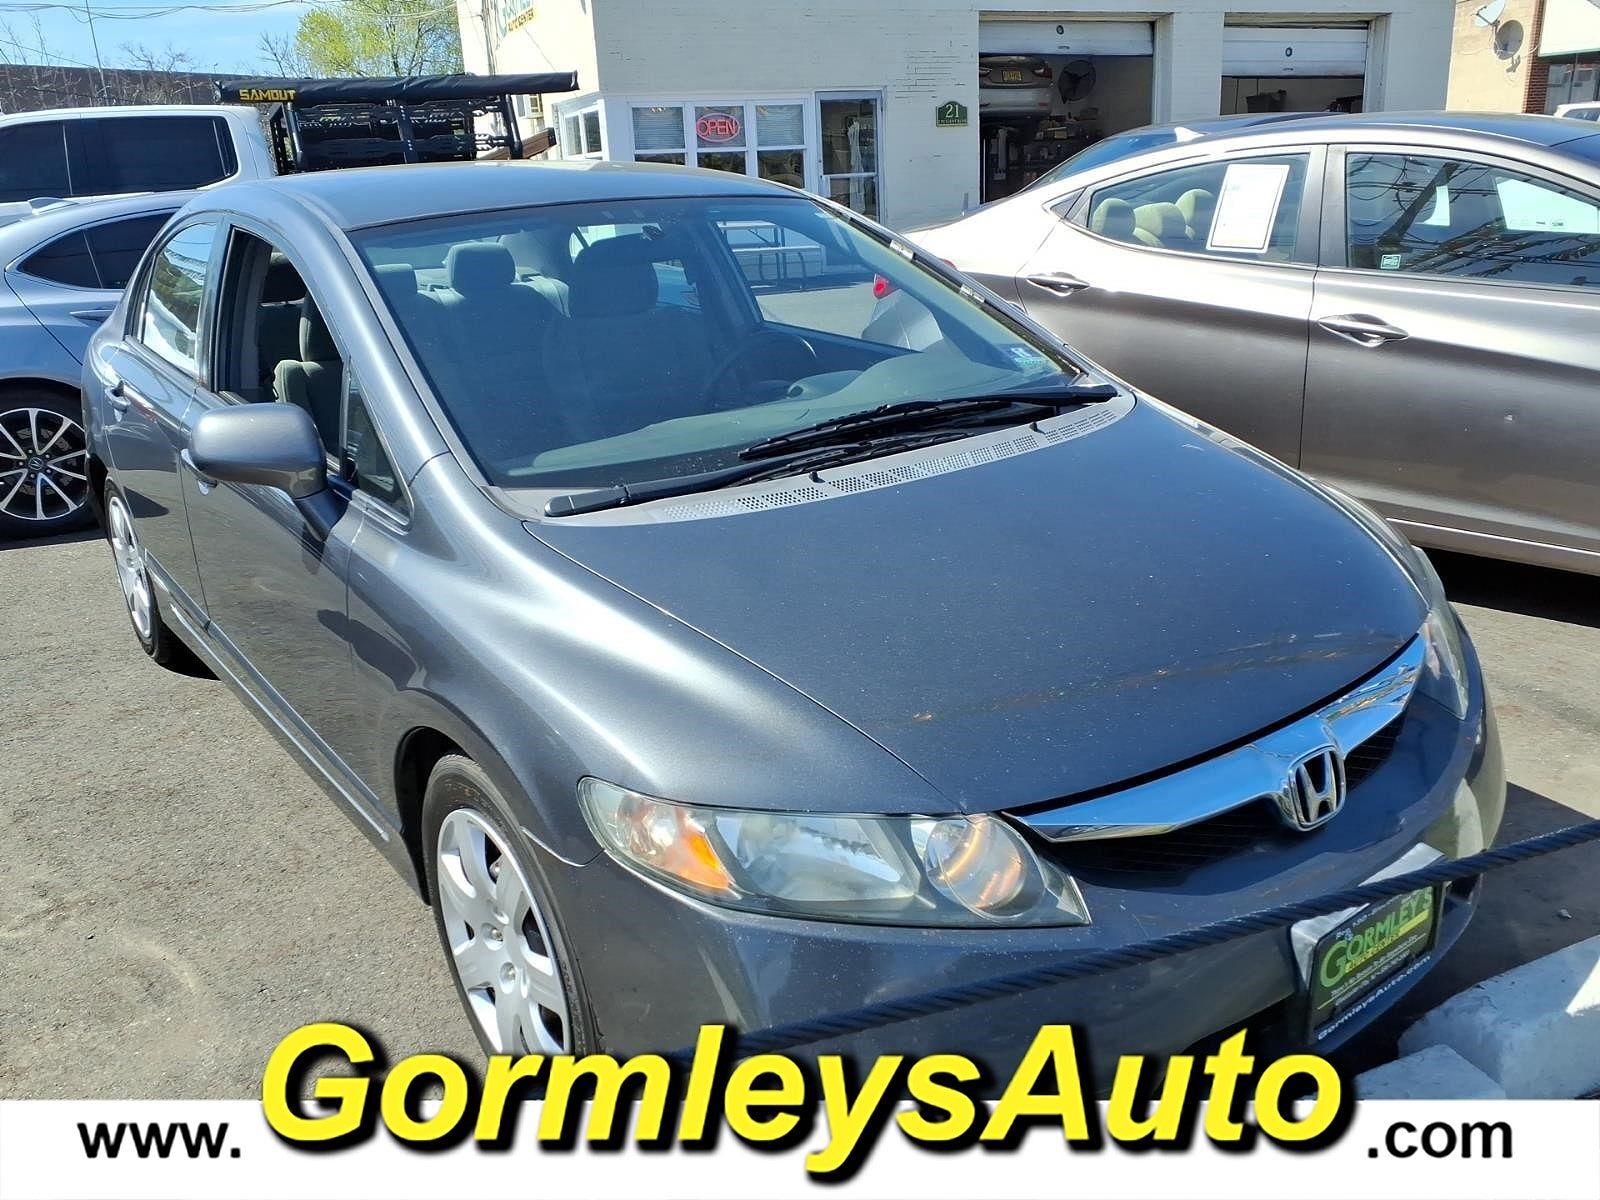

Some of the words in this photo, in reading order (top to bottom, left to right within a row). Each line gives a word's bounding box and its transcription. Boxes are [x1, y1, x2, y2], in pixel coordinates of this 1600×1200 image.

[239, 89, 296, 102] SAMOUT
[945, 103, 960, 118] 21
[700, 119, 737, 137] OPEN
